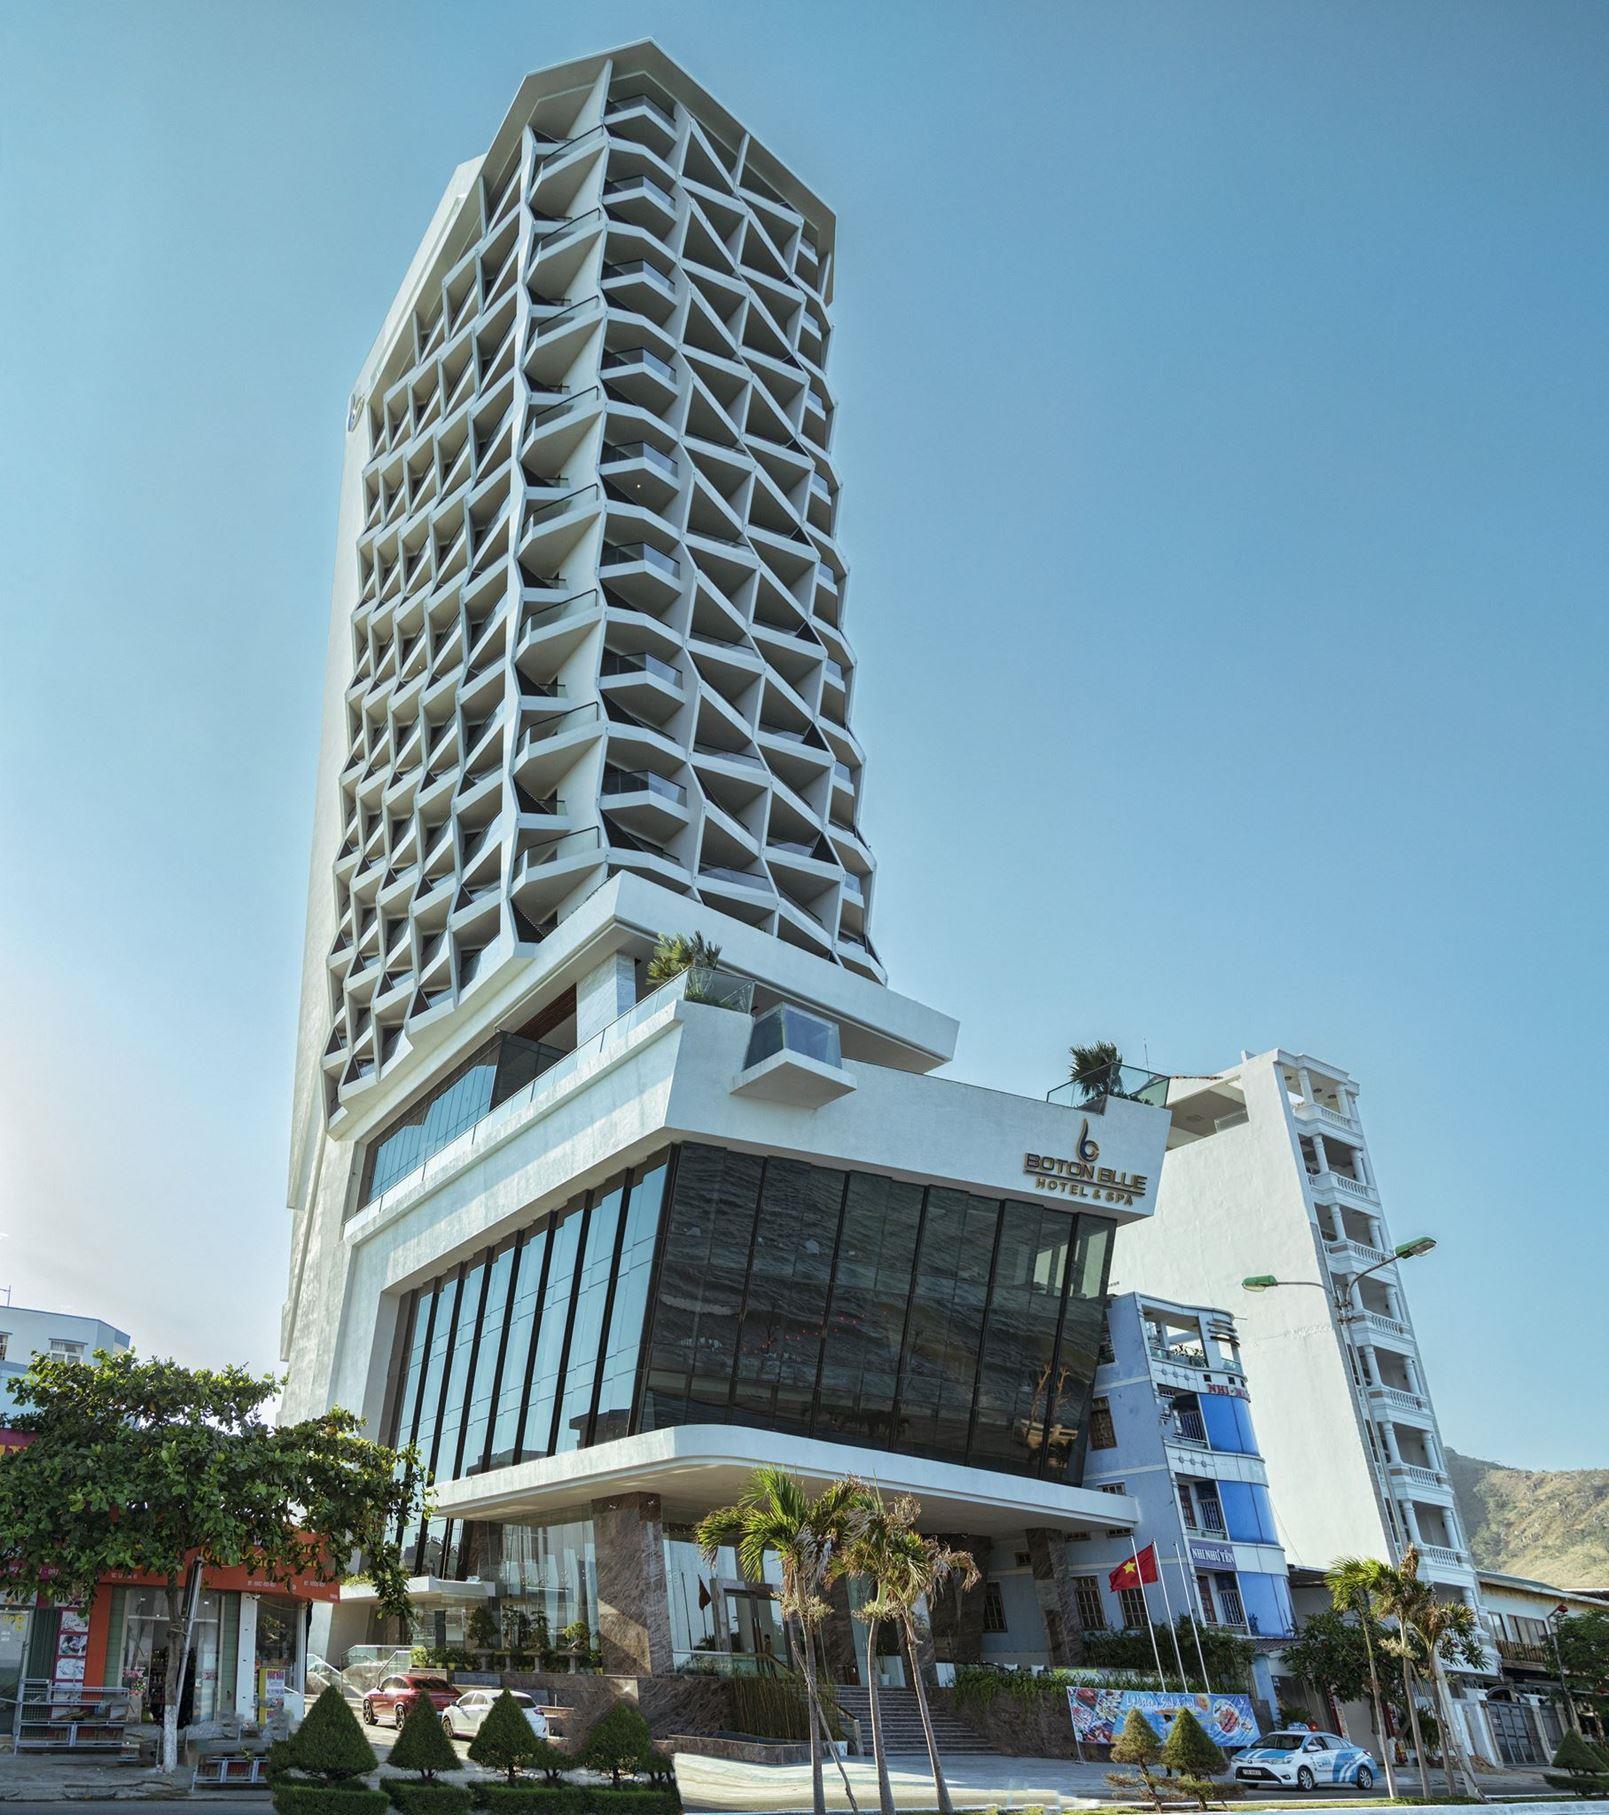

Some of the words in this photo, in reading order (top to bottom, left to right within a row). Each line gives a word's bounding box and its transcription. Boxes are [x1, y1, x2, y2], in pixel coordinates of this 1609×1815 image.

[1024, 1153, 1094, 1179] BOTON
[1097, 1167, 1147, 1189] BLUE
[1035, 1177, 1088, 1197] HOTEL
[1092, 1188, 1101, 1199] &
[1104, 1191, 1133, 1205] SPA
